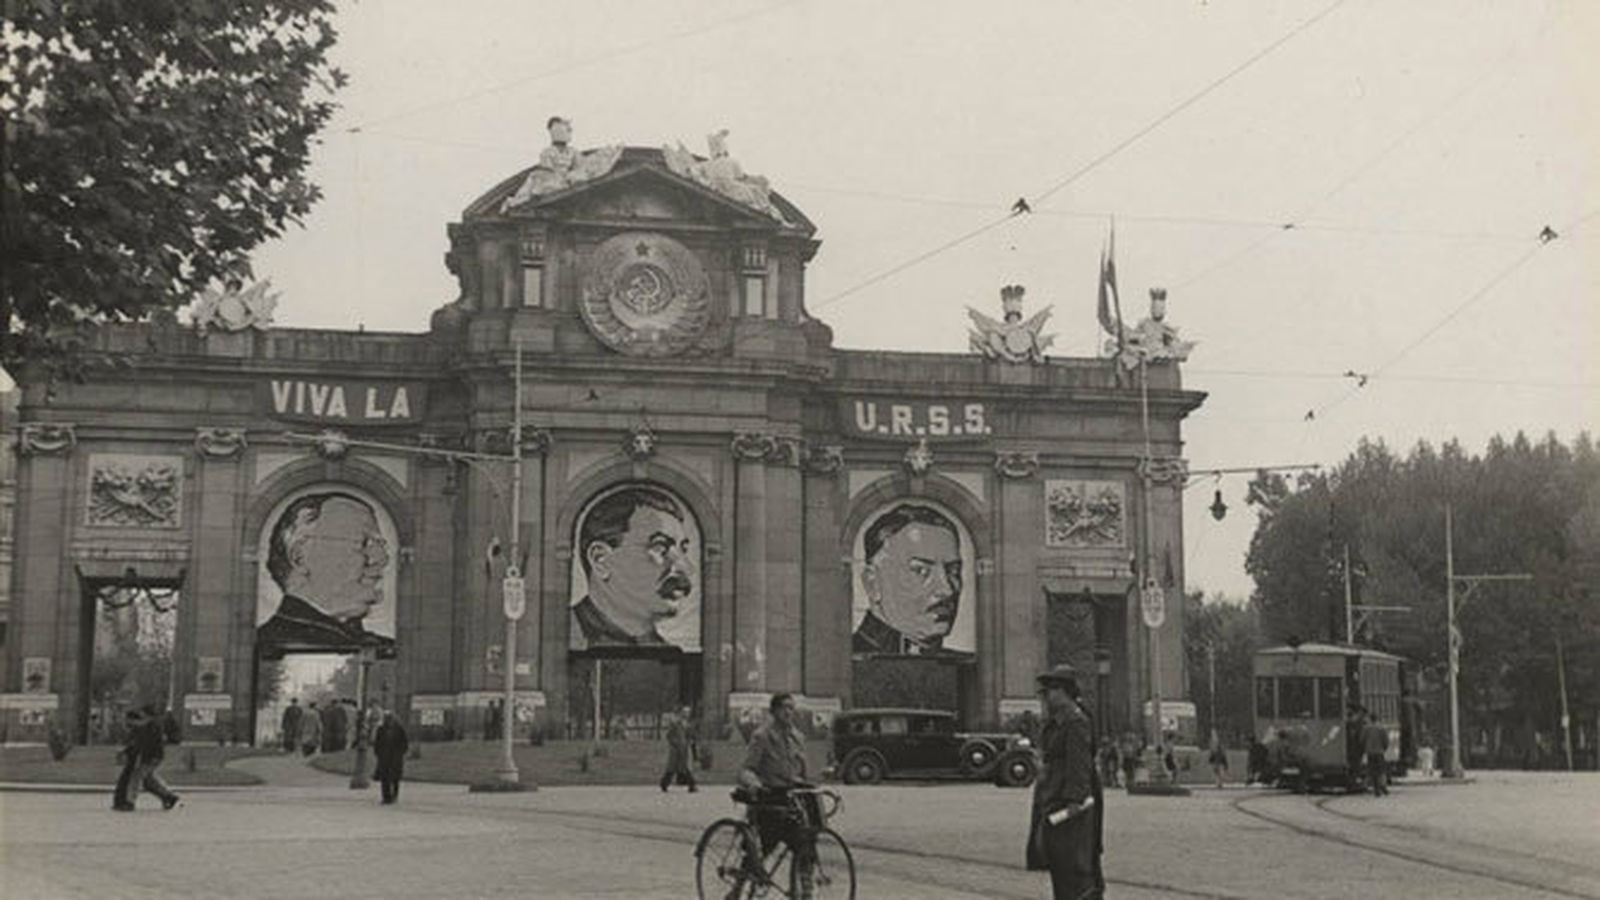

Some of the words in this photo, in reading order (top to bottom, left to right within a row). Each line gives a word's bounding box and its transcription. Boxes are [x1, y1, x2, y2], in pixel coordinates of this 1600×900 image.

[271, 380, 347, 418] VIVA
[364, 386, 411, 418] LA
[855, 401, 992, 435] U.R.S.S.
